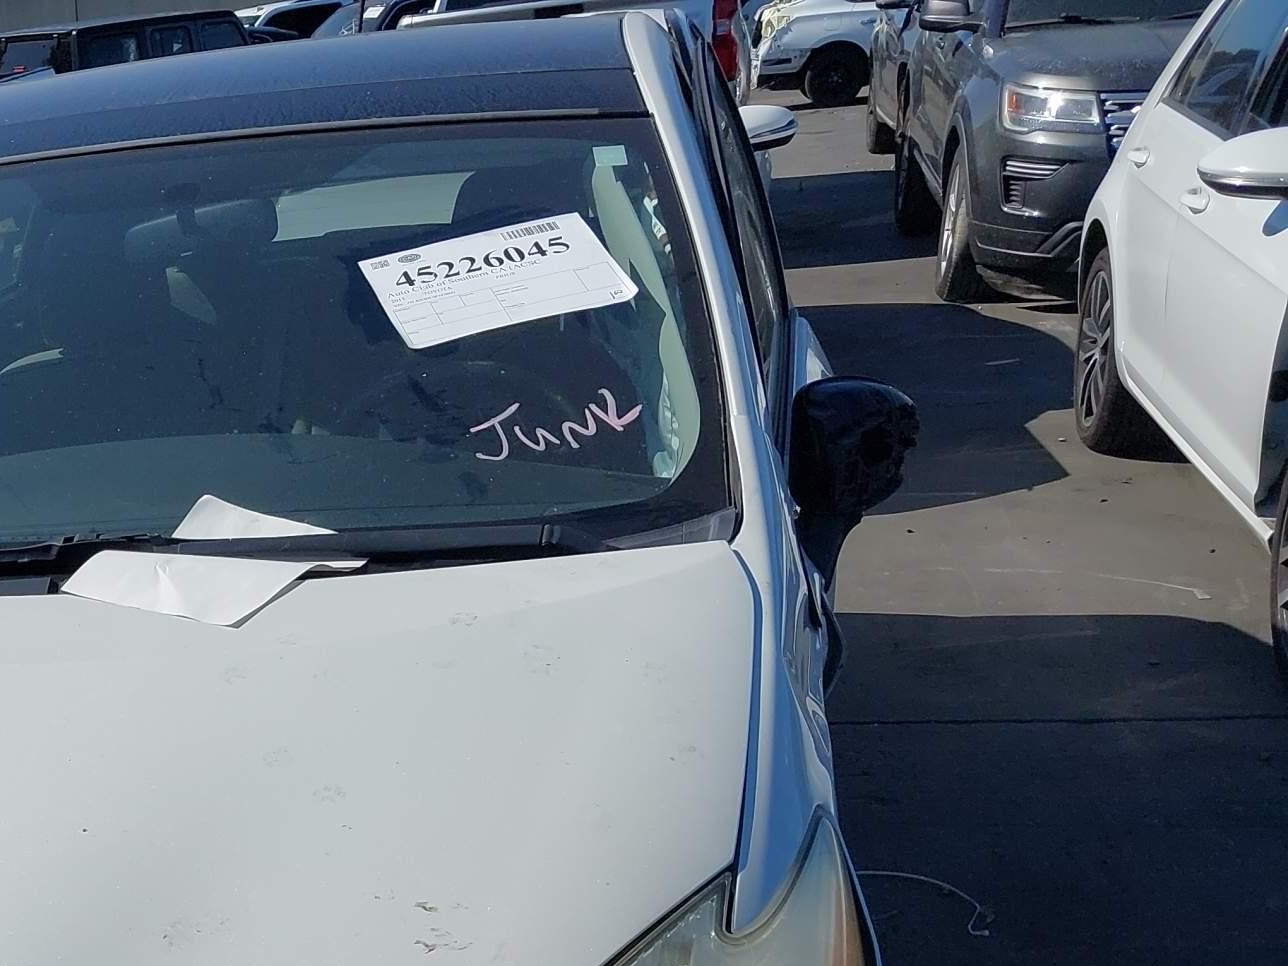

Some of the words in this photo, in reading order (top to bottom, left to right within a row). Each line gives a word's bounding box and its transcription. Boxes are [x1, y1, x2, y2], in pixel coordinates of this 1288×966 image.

[395, 236, 570, 287] 45226045
[388, 288, 411, 299] Auto
[412, 281, 435, 293] Club
